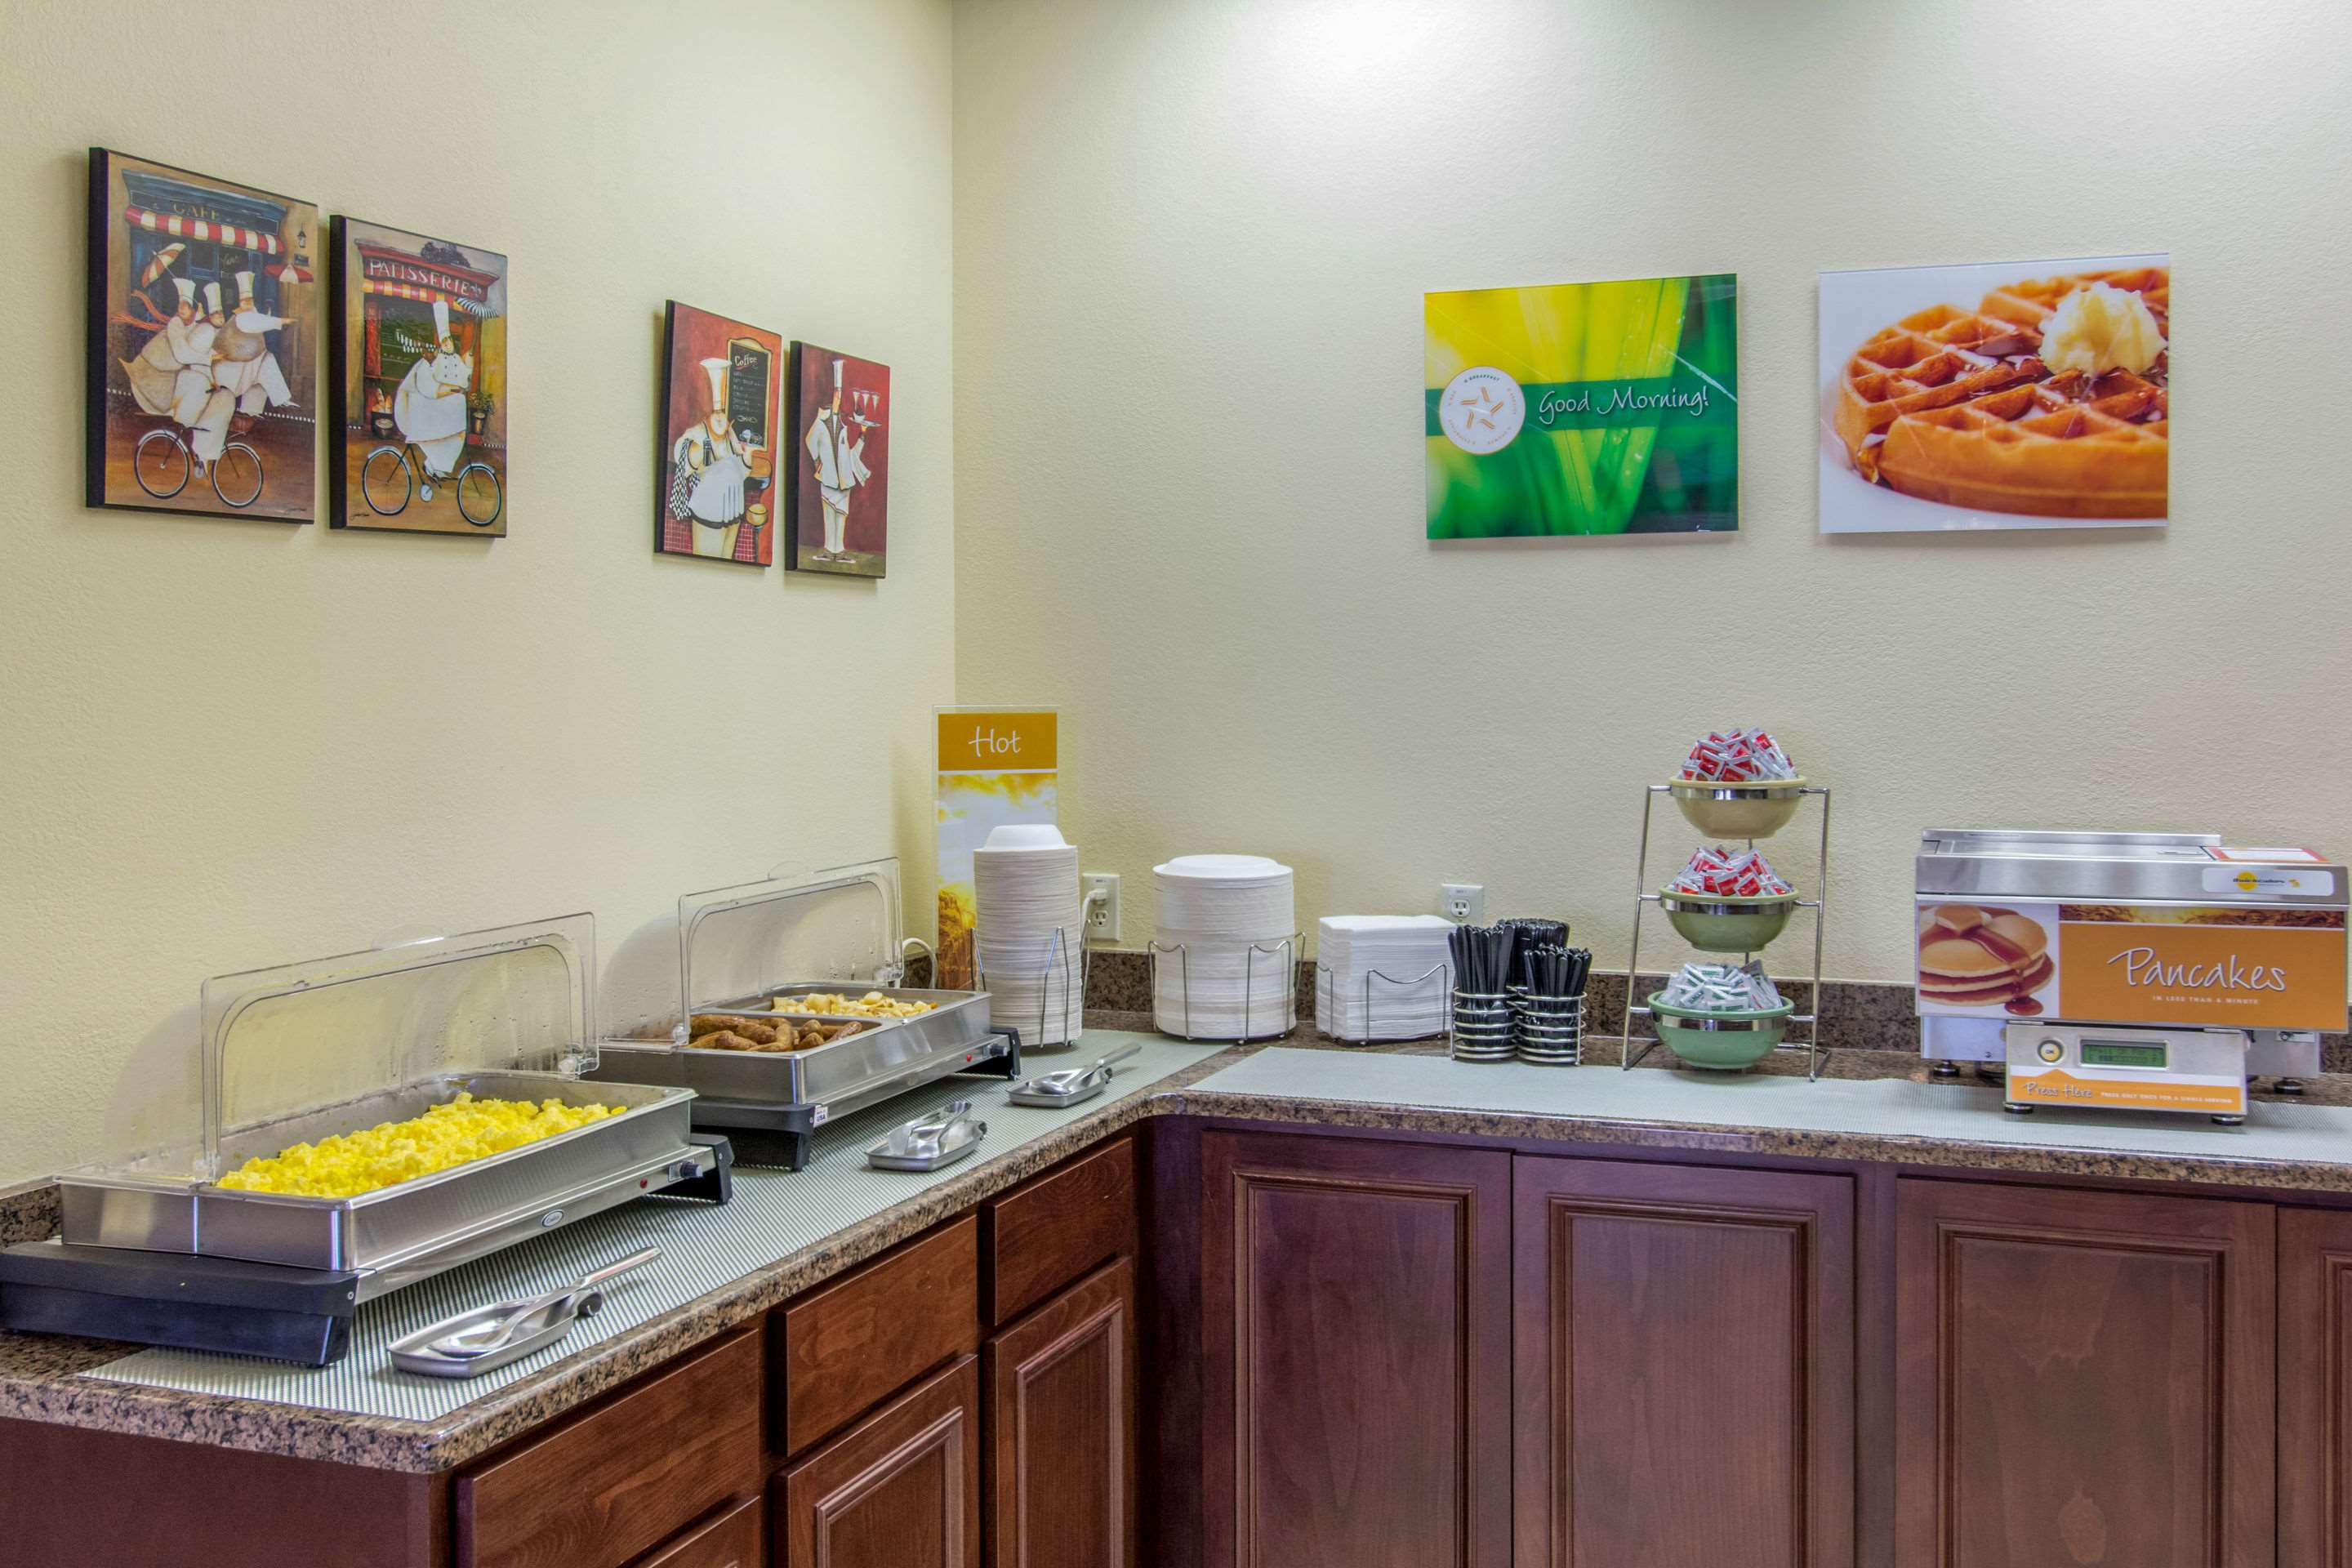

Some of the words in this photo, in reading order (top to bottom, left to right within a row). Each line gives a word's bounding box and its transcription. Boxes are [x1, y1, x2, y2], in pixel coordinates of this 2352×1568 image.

[369, 259, 470, 296] PATISSERIE
[734, 353, 758, 367] Coffee
[1539, 390, 1590, 425] Good
[1597, 385, 1709, 416] Morning!
[968, 725, 1022, 757] Hot
[2106, 947, 2287, 991] Pancakes
[2062, 1084, 2092, 1098] Here
